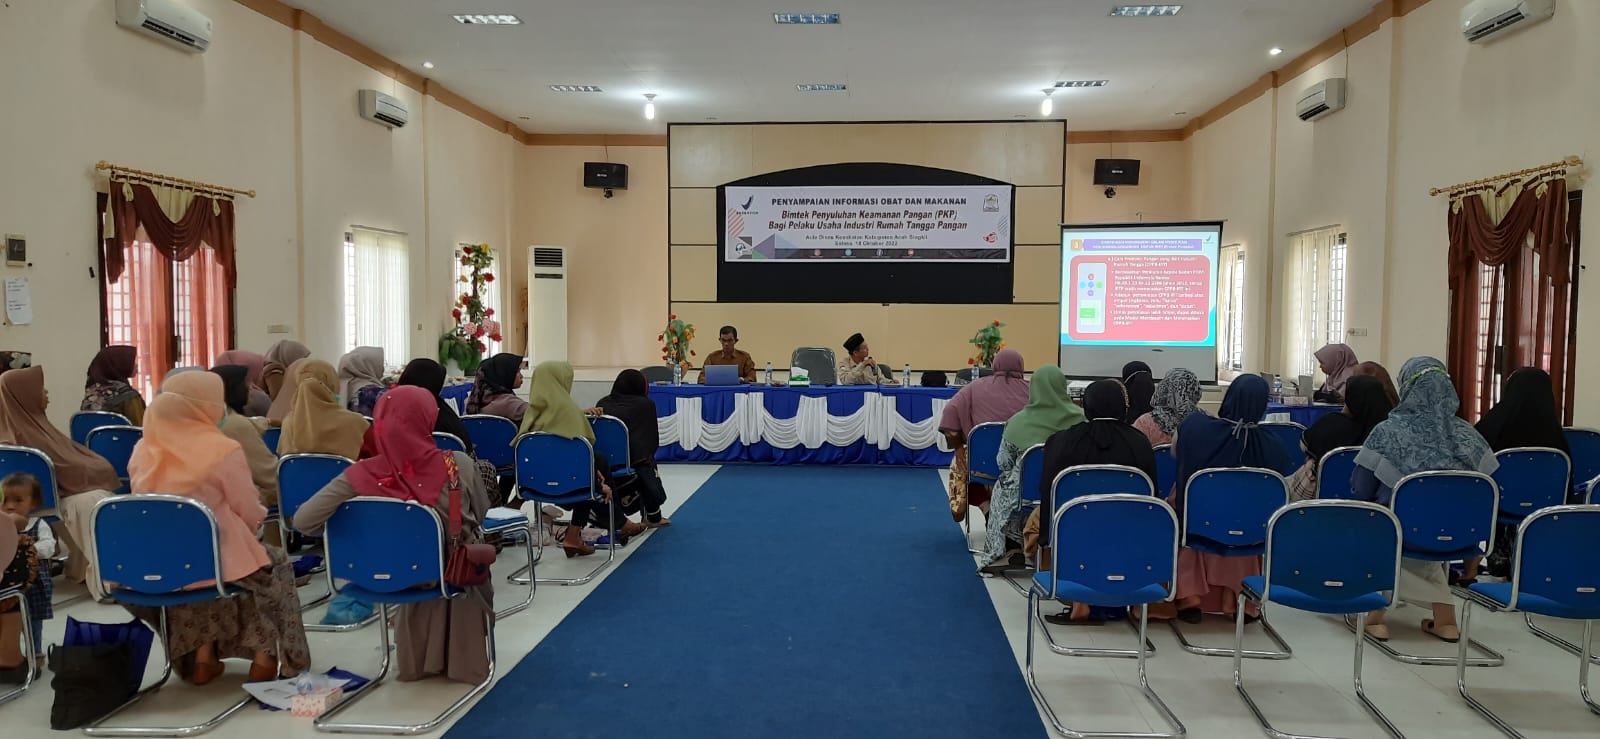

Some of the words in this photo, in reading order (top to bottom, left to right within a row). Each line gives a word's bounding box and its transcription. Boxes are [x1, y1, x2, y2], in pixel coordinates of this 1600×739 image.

[771, 198, 830, 206] PENYAMPAIAN
[832, 198, 878, 206] INFORMASI
[880, 197, 902, 205] OBAT
[904, 197, 922, 205] DAN
[924, 197, 967, 205] MAKANAN
[781, 210, 810, 219] Bimtek
[811, 210, 857, 220] Penyuluhan
[858, 210, 901, 219] Keamanan
[902, 210, 933, 220] Pangan
[934, 210, 958, 220] (PKP)
[768, 221, 787, 231] Bagi
[788, 221, 815, 230] Pelaku
[817, 221, 842, 230] Usaha
[843, 220, 875, 230] Industri
[876, 221, 904, 230] Rumah
[905, 221, 936, 232] Tangga
[937, 221, 968, 232] Pangan
